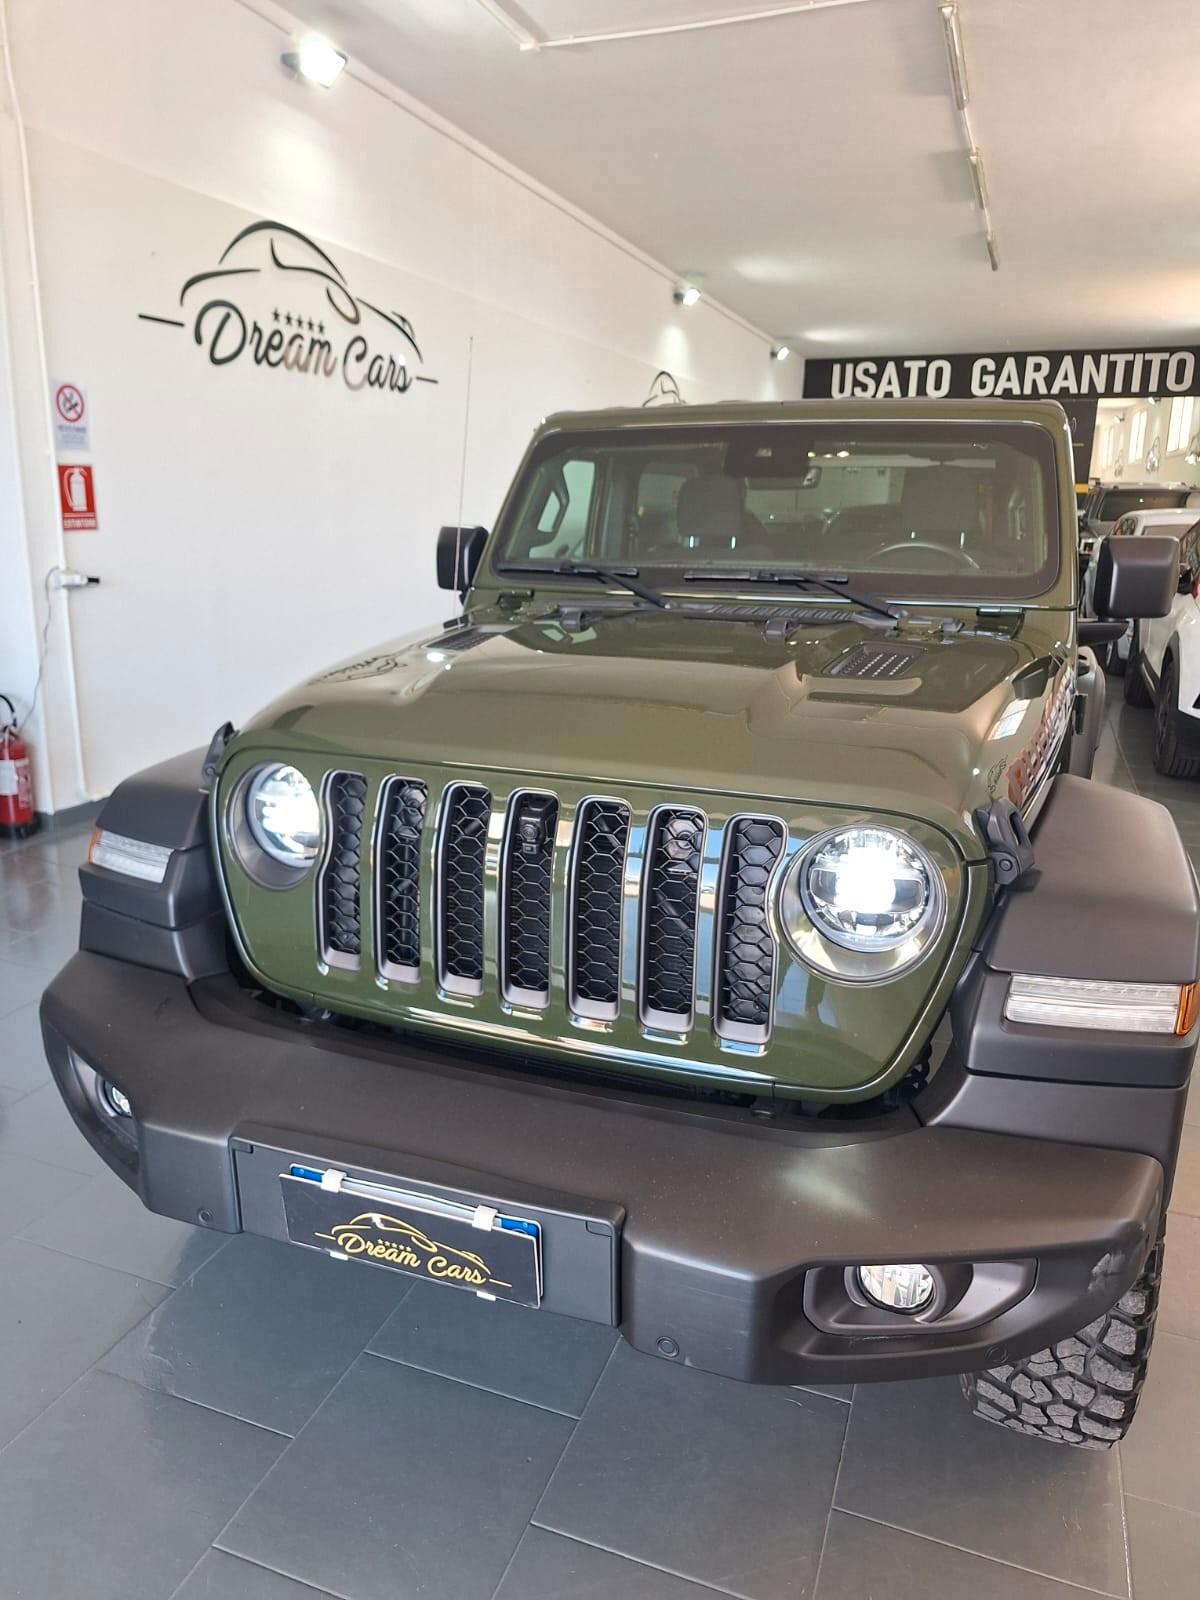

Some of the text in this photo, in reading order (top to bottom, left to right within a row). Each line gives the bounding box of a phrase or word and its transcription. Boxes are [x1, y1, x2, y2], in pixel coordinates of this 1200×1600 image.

[194, 299, 412, 394] Dream Cars
[831, 351, 1196, 399] USATO GARANTITO
[336, 1232, 487, 1285] Dream Cars
